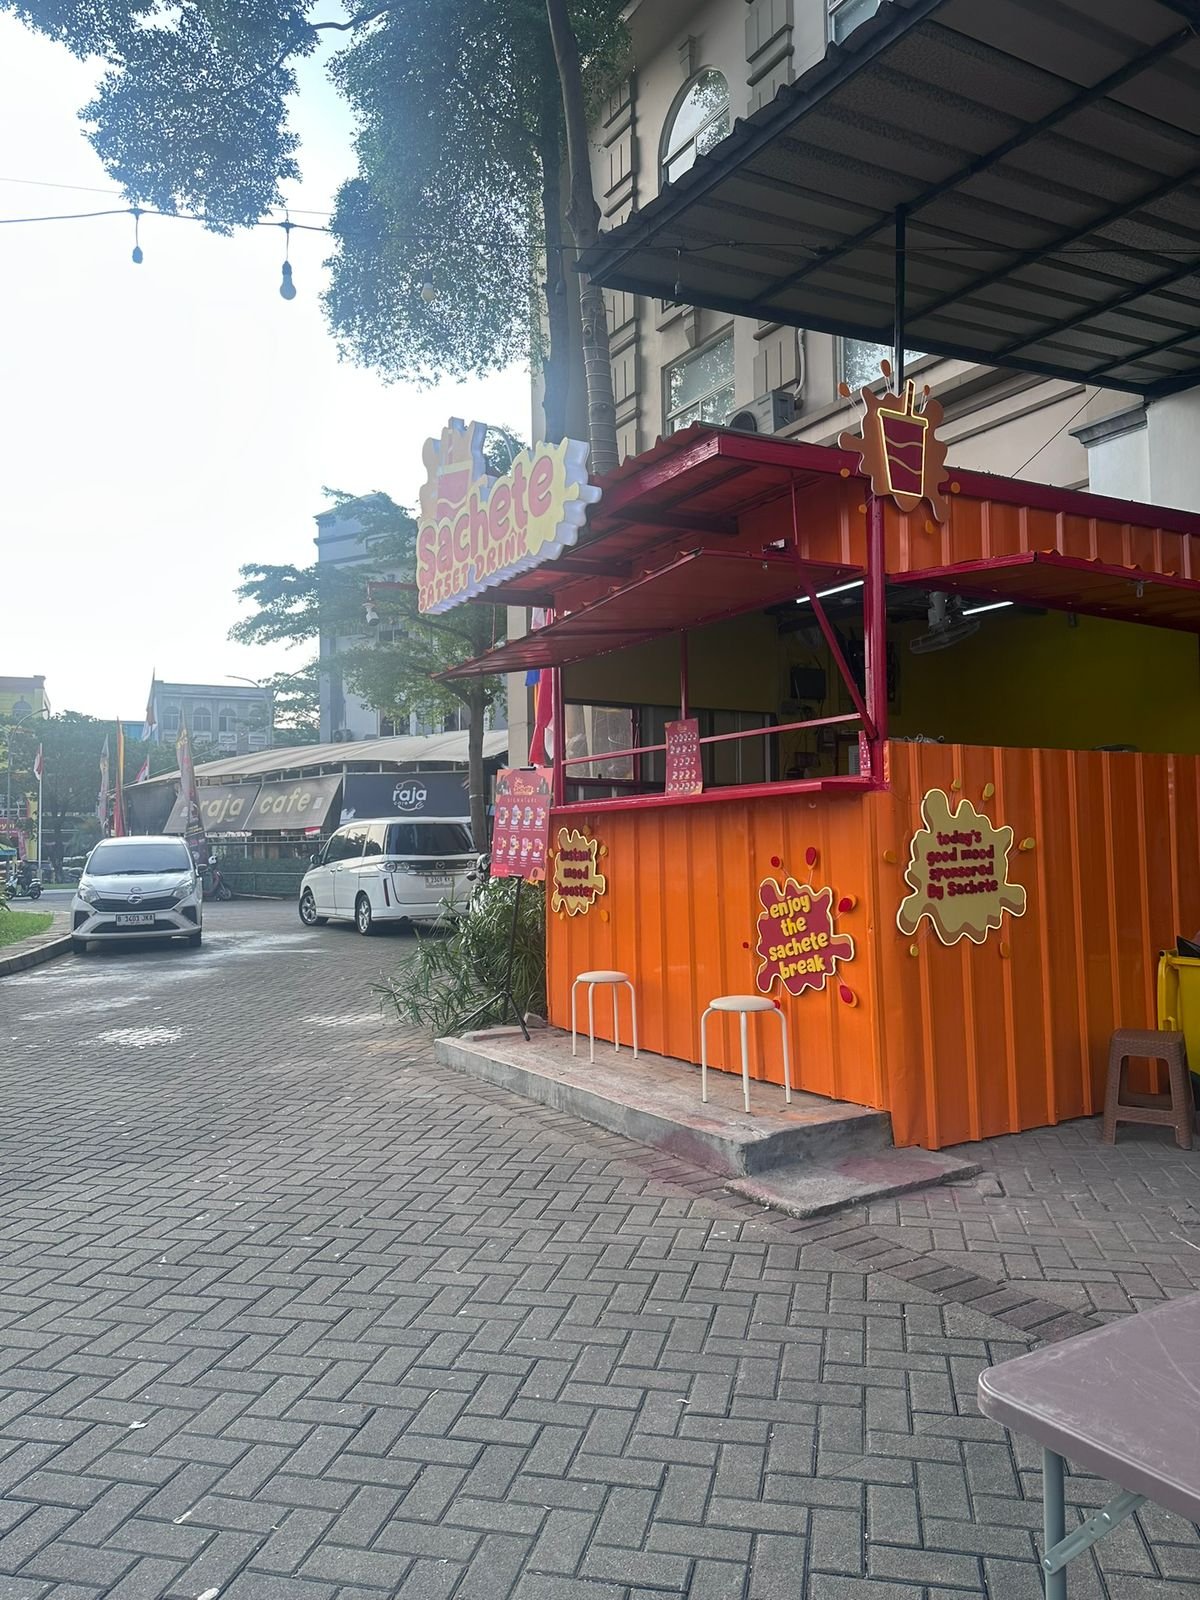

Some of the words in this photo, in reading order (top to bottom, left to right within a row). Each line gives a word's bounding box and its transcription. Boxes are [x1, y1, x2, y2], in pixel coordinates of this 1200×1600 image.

[418, 565, 469, 612] SATSET
[474, 528, 528, 580] DRINK
[200, 793, 246, 824] raja
[259, 787, 312, 814] cafe
[392, 786, 427, 804] raja
[936, 829, 982, 847] today's
[926, 847, 957, 866] good
[960, 845, 995, 861] mood
[563, 865, 589, 880] mood
[928, 861, 994, 881] sponsored
[557, 880, 594, 898] booster
[947, 878, 999, 897] Sachete
[769, 894, 811, 918] enjoy
[780, 916, 807, 937] the
[768, 931, 829, 962] sachete
[778, 953, 826, 980] break
